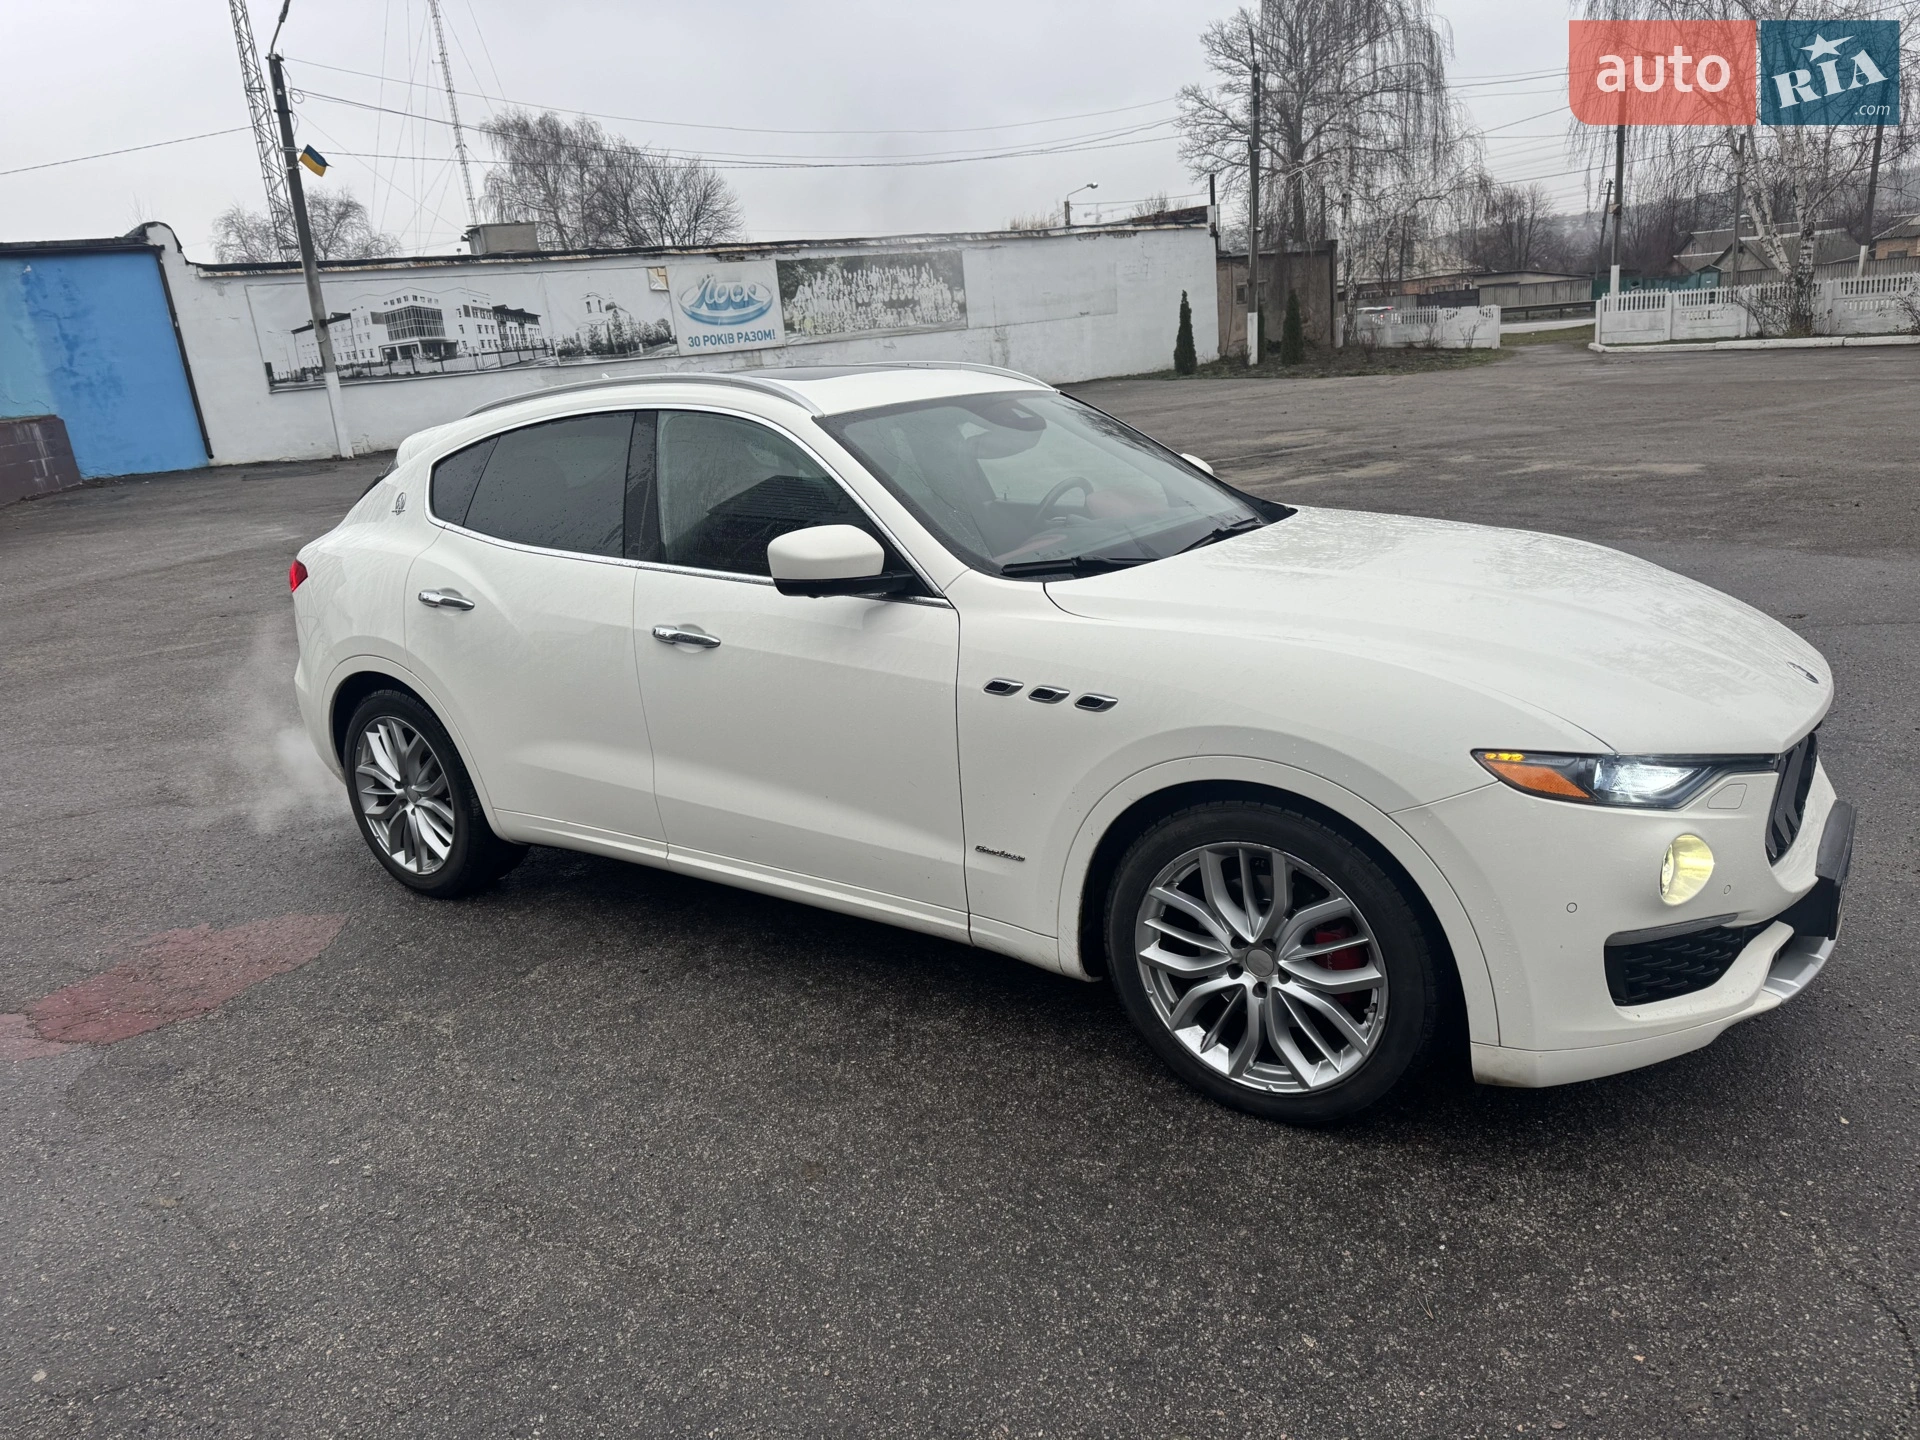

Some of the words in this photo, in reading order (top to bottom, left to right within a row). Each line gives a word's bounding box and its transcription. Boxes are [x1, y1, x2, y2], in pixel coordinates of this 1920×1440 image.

[688, 335, 701, 348] 30
[702, 333, 735, 347] РОКІВ
[736, 329, 776, 344] РАЗОМ!
